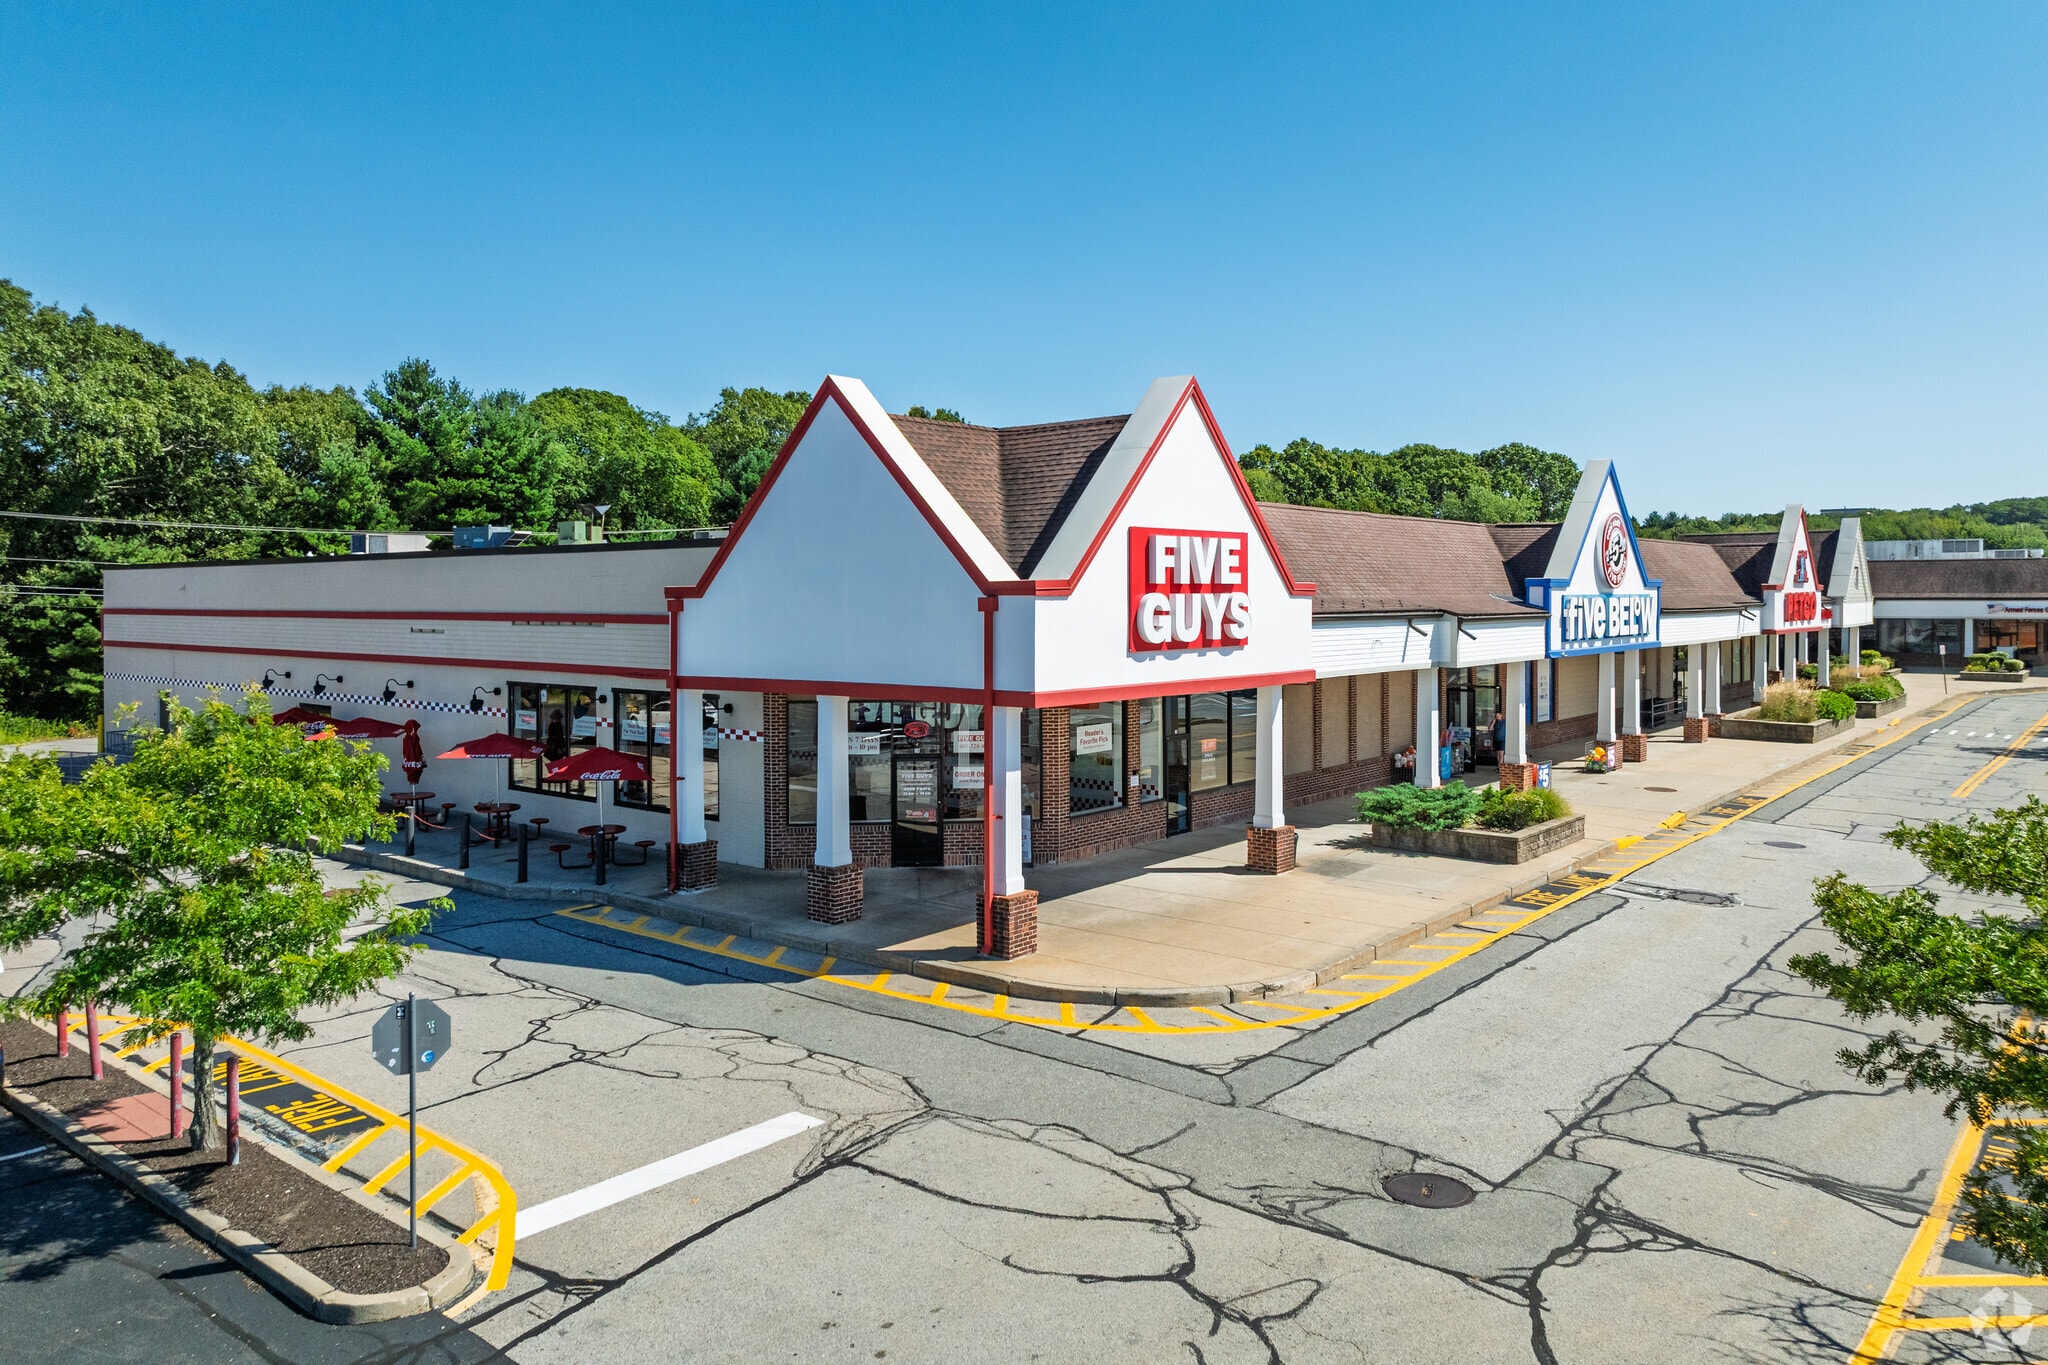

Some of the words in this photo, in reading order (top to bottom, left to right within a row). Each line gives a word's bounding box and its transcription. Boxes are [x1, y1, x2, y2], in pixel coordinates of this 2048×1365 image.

[1149, 535, 1242, 585] FIVE
[1137, 592, 1251, 644] GUYS
[1784, 592, 1817, 622] PETCO
[1084, 729, 1104, 737] Reader's
[580, 769, 622, 780] Coca-Cola
[264, 1093, 368, 1134] FIRE
